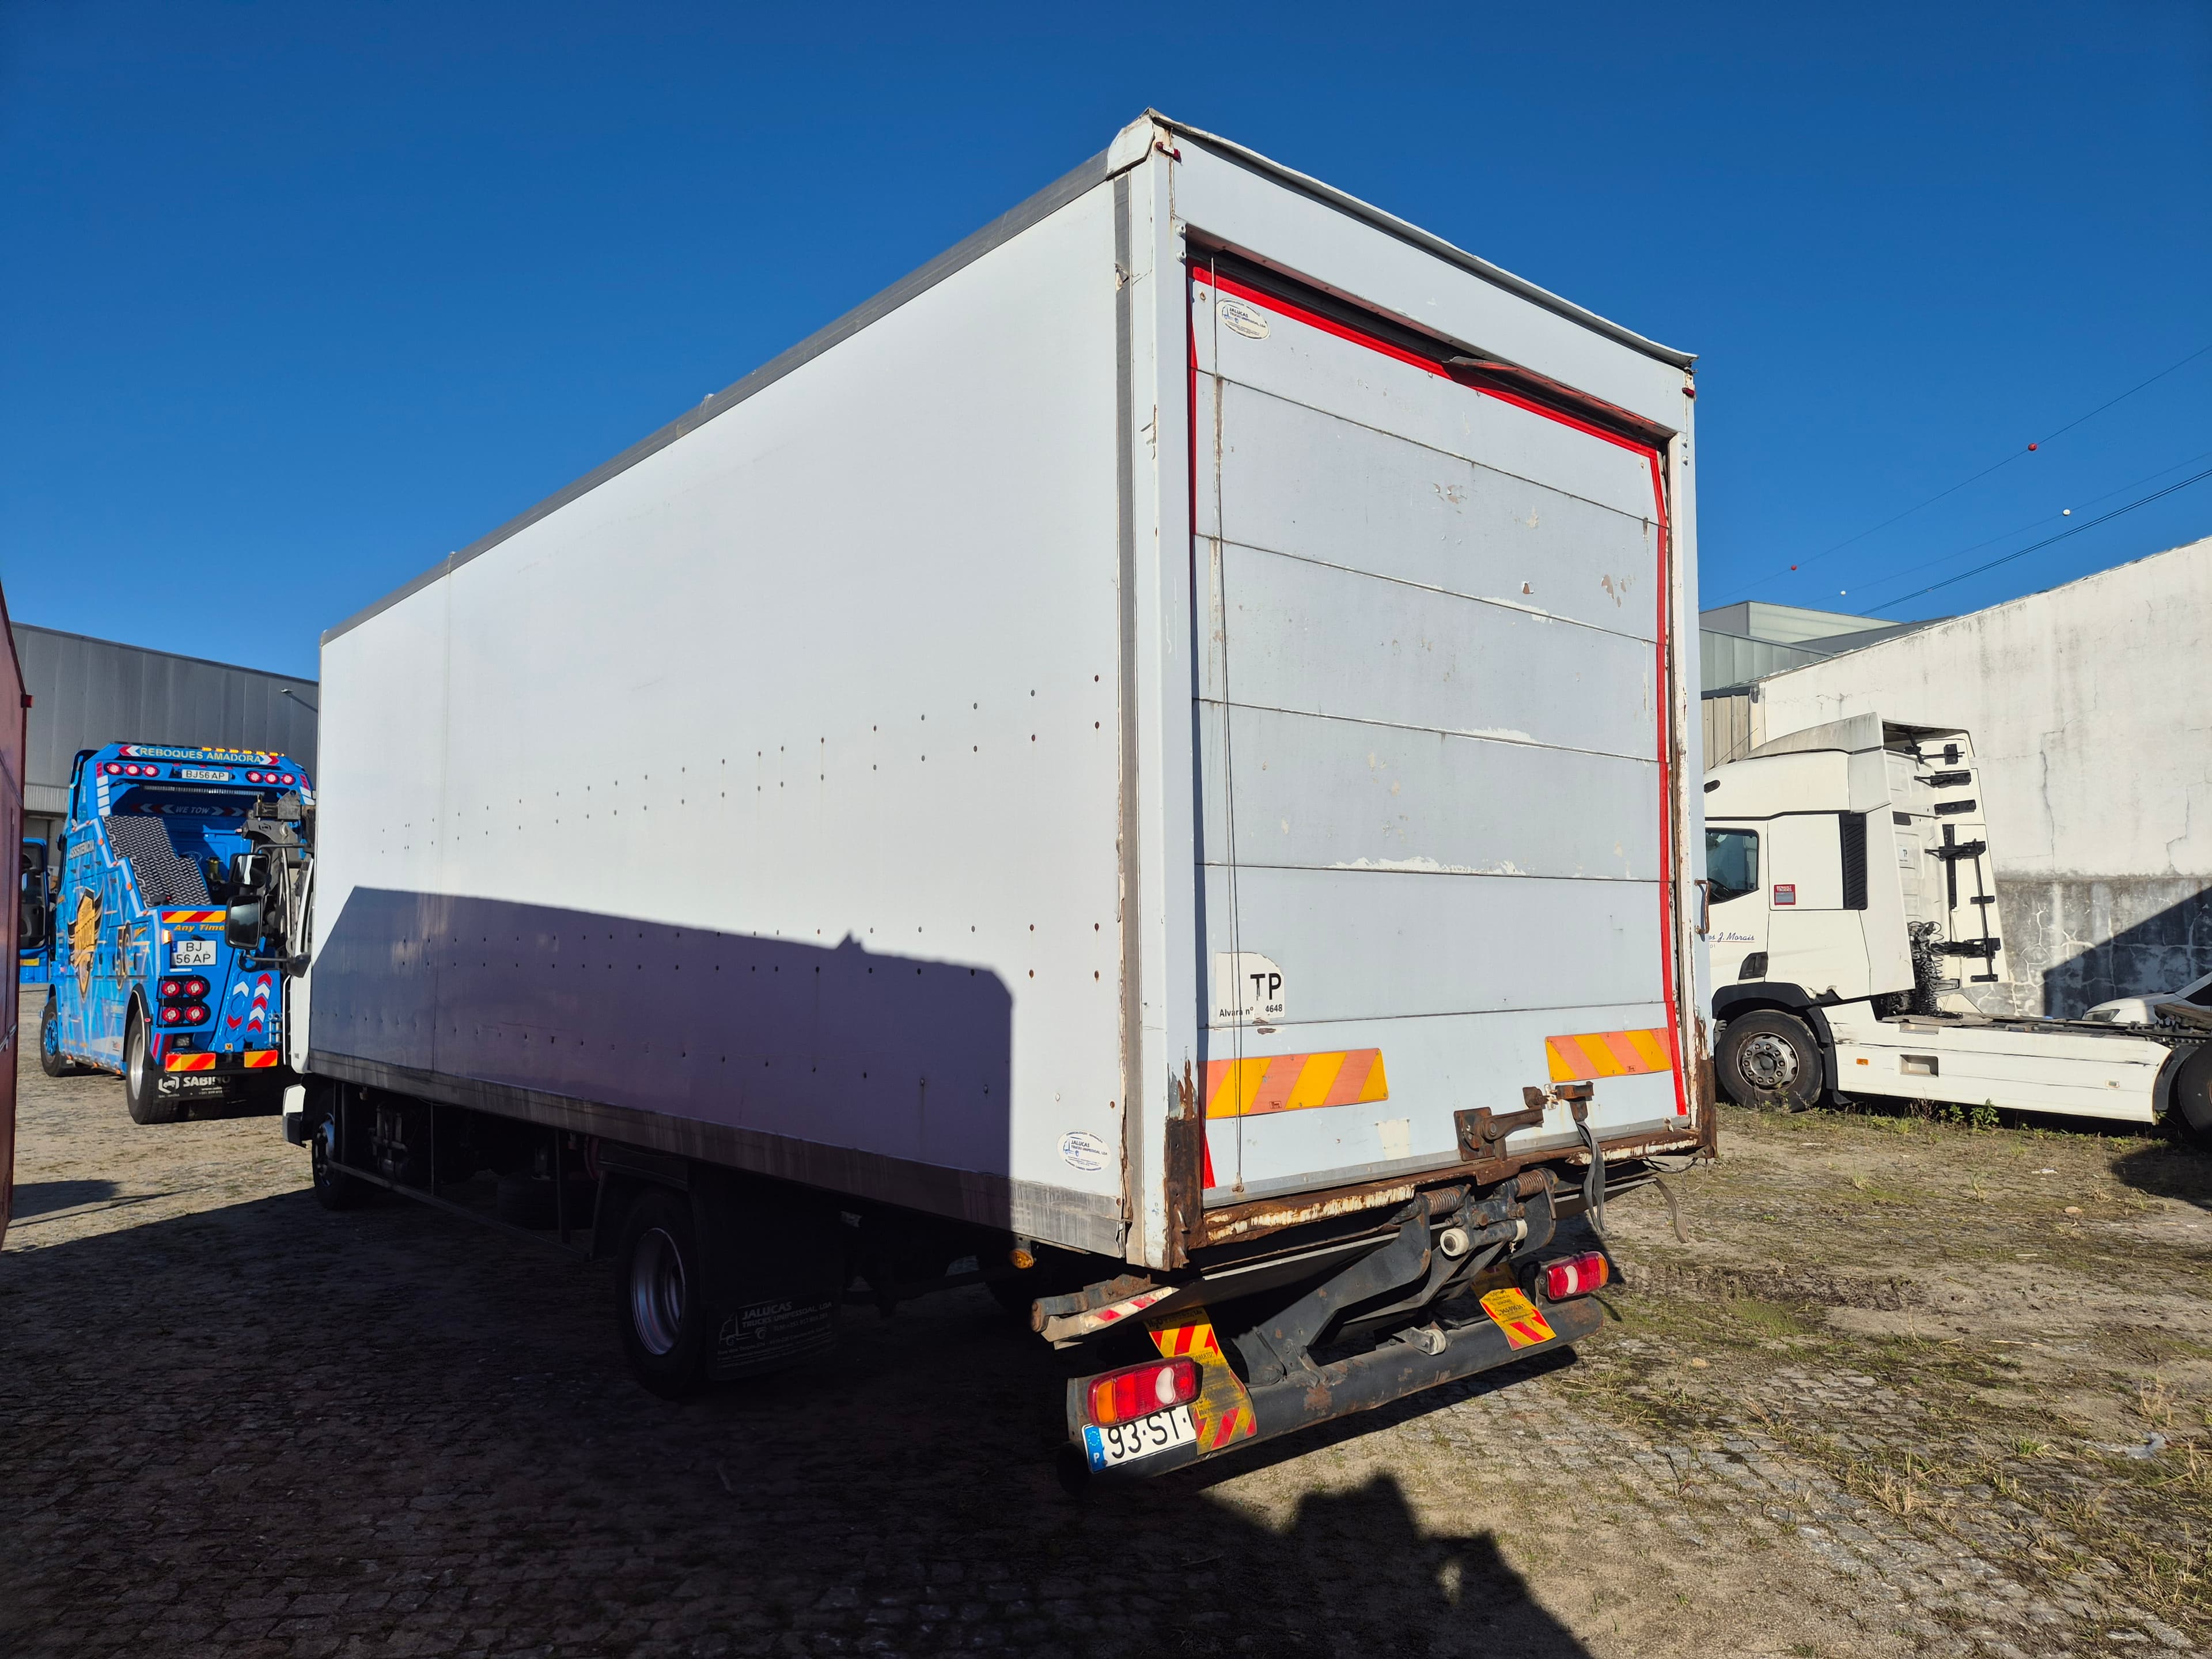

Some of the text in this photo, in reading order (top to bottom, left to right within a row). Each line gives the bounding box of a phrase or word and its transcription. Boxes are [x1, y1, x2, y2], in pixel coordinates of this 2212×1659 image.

[1229, 307, 1248, 318] JALUCAS
[140, 748, 261, 763] REBOQUES AMADORA
[190, 806, 210, 815] TOW
[173, 924, 195, 933] Any
[1726, 932, 1755, 941] Morais
[186, 942, 202, 952] BJ
[176, 953, 211, 964] 56 AP
[1250, 972, 1282, 1001] TP
[1265, 1003, 1283, 1013] 4648
[1071, 1139, 1090, 1148] JALUCAS
[742, 1301, 793, 1320] JALUCAS
[742, 1316, 772, 1329] TRUCKS
[1093, 1452, 1101, 1464] P
